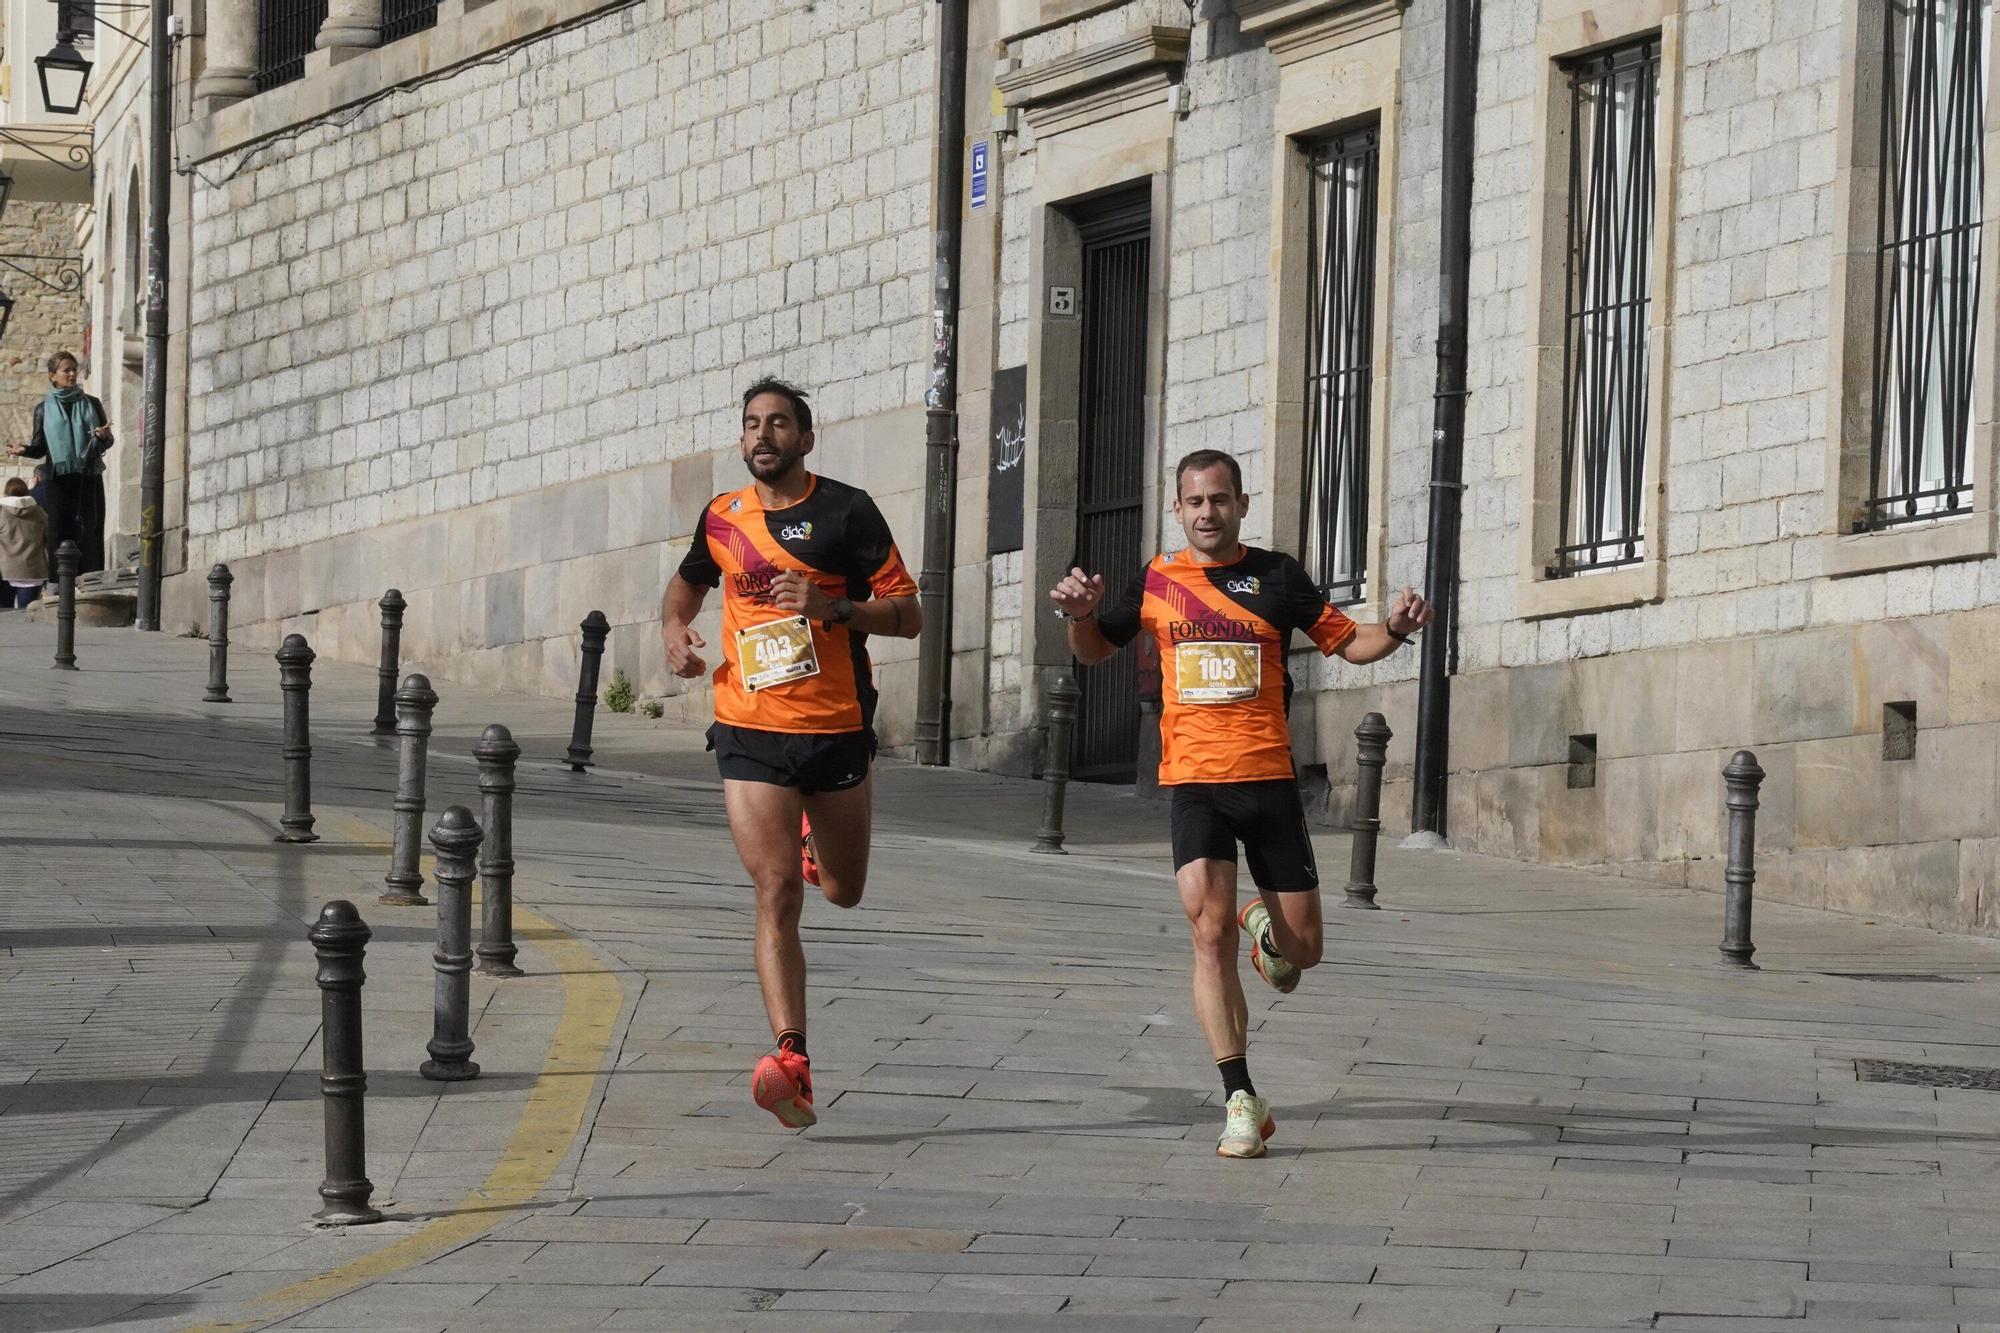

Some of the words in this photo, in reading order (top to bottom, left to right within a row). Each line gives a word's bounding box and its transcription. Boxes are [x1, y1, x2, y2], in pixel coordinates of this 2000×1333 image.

[1055, 291, 1070, 310] 3
[1168, 621, 1257, 639] FORONDA
[755, 635, 793, 662] 403
[1199, 657, 1236, 680] 103
